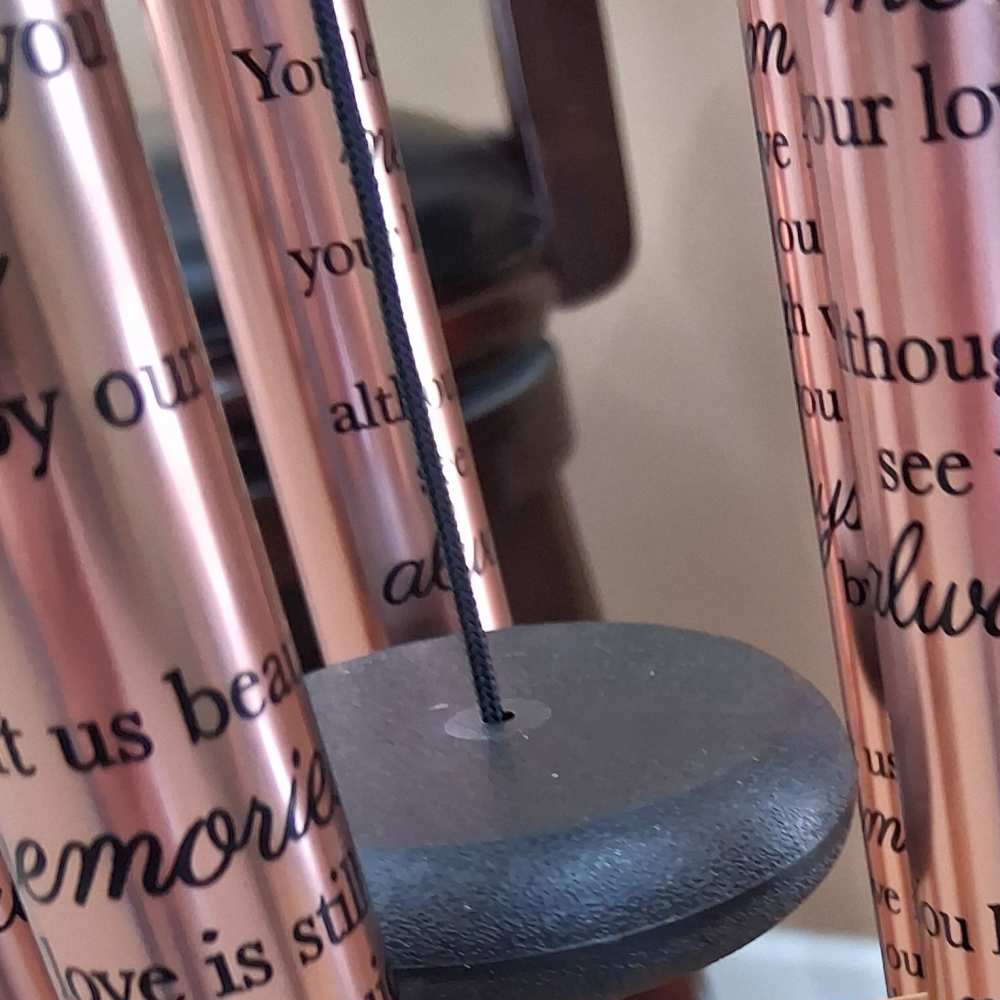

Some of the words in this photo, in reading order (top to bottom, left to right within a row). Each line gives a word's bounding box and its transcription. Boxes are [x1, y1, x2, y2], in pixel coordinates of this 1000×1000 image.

[879, 448, 973, 496] see
[50, 710, 153, 772] us
[164, 642, 298, 745] bea
[203, 929, 274, 998] is
